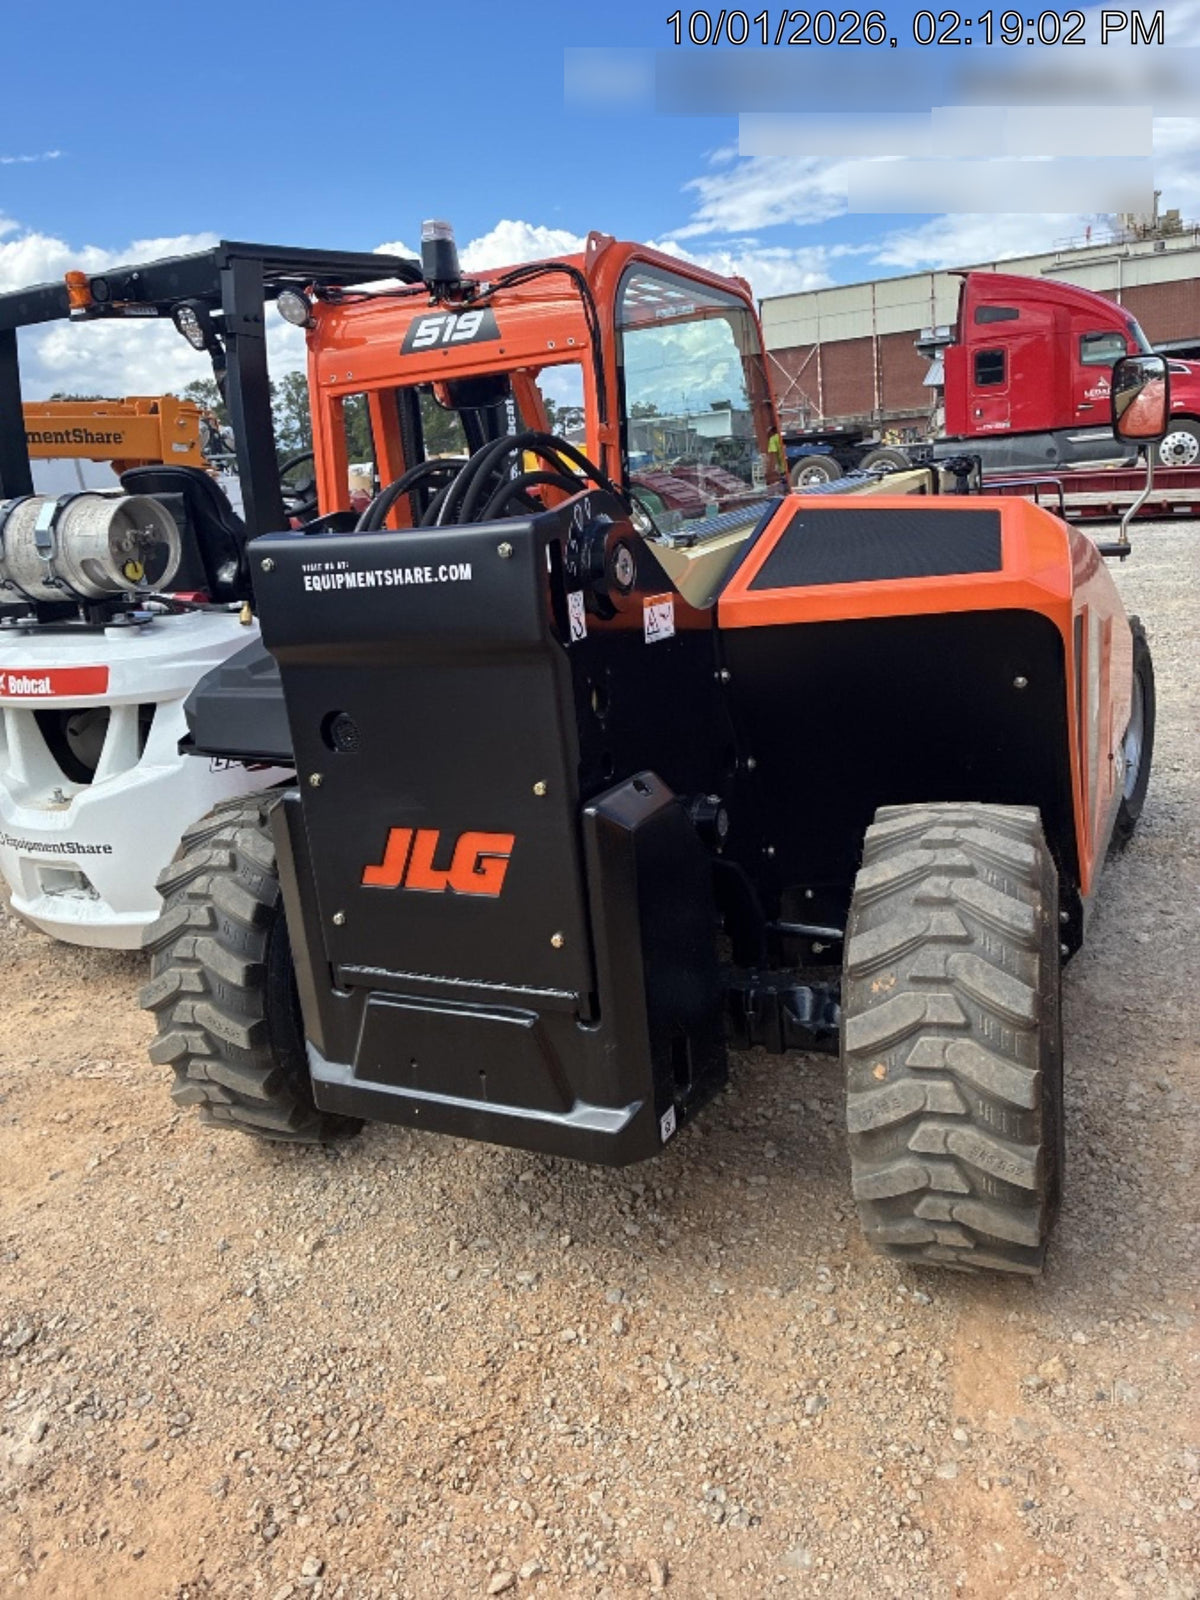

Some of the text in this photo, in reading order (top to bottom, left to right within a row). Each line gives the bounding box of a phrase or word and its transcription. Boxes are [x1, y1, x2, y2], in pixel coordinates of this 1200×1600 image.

[412, 311, 484, 348] 519
[303, 563, 472, 592] EQUIPMENTSHARE.COM
[8, 675, 50, 694] Bobcat
[360, 827, 516, 898] JLG
